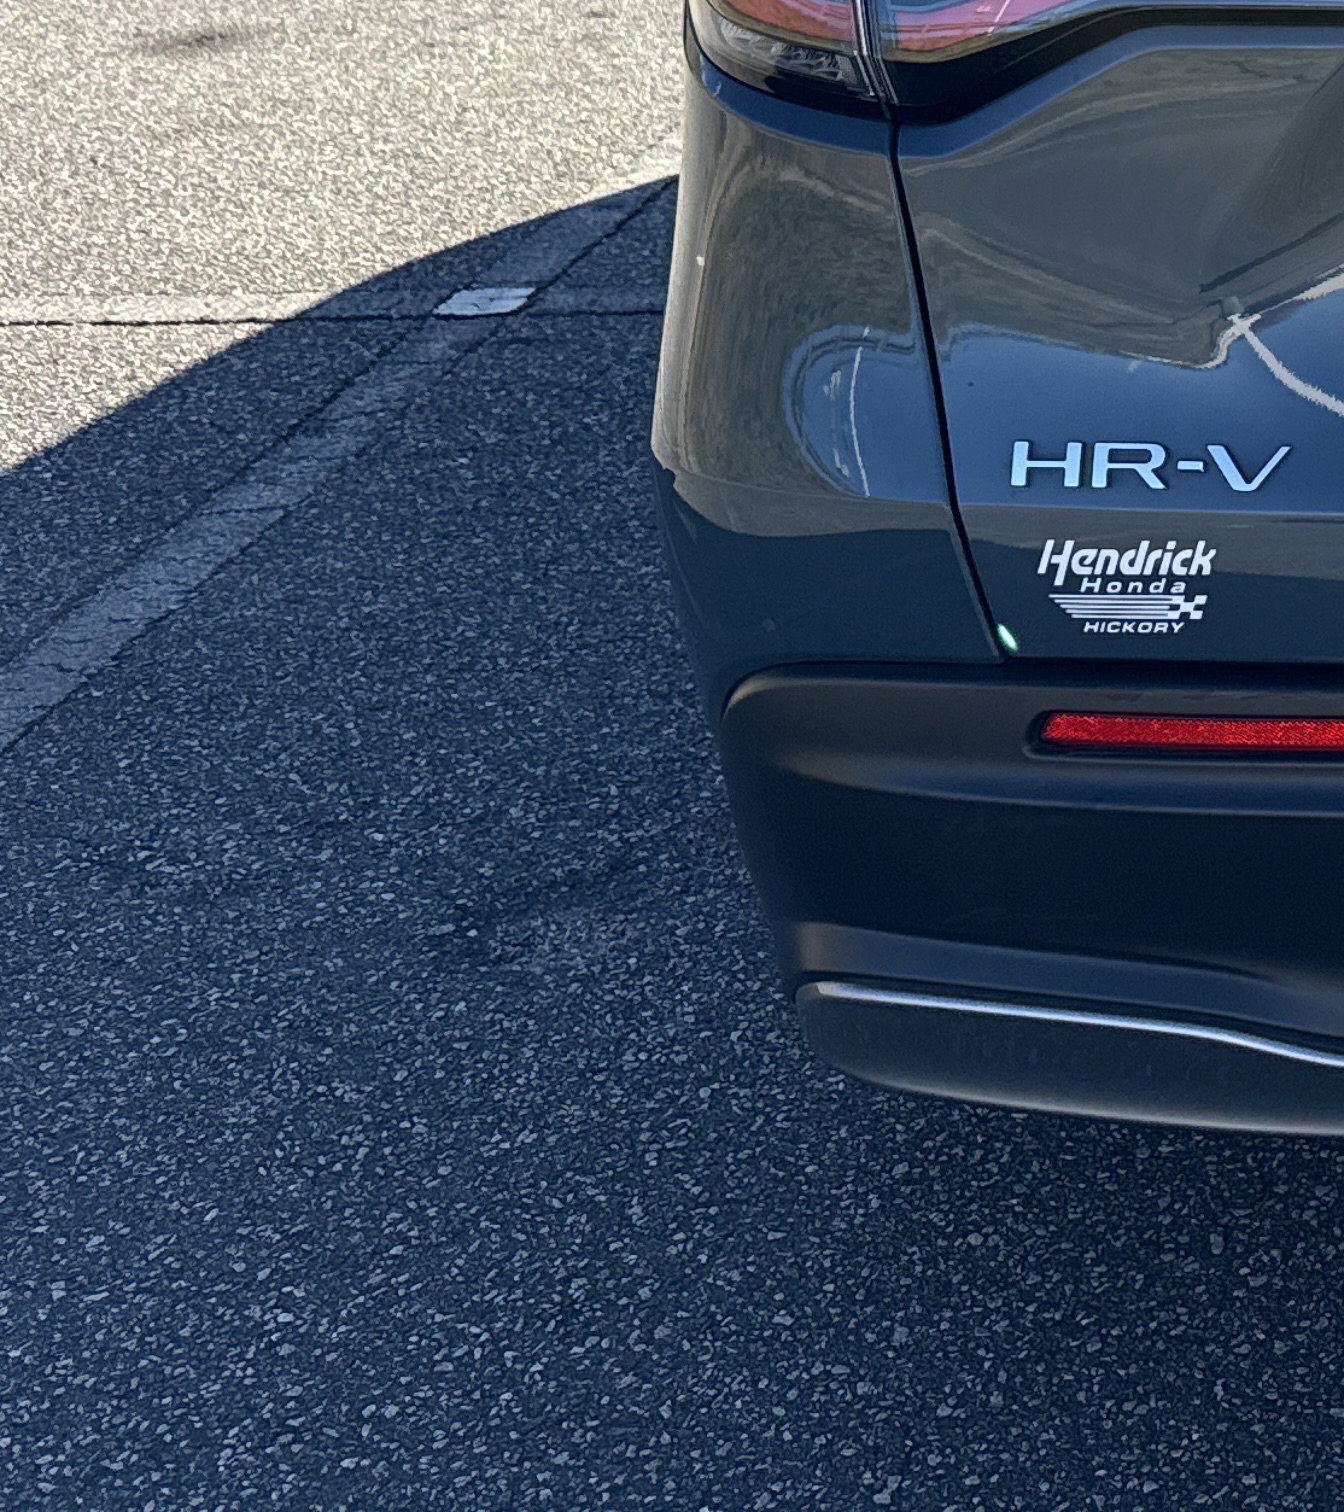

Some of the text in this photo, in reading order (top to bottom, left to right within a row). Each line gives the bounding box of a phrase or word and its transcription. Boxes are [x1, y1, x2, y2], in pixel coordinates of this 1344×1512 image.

[1010, 441, 1292, 492] HR-V
[1037, 539, 1217, 586] Hendrick
[1080, 578, 1187, 593] Honda
[1083, 621, 1186, 634] HICKORY
